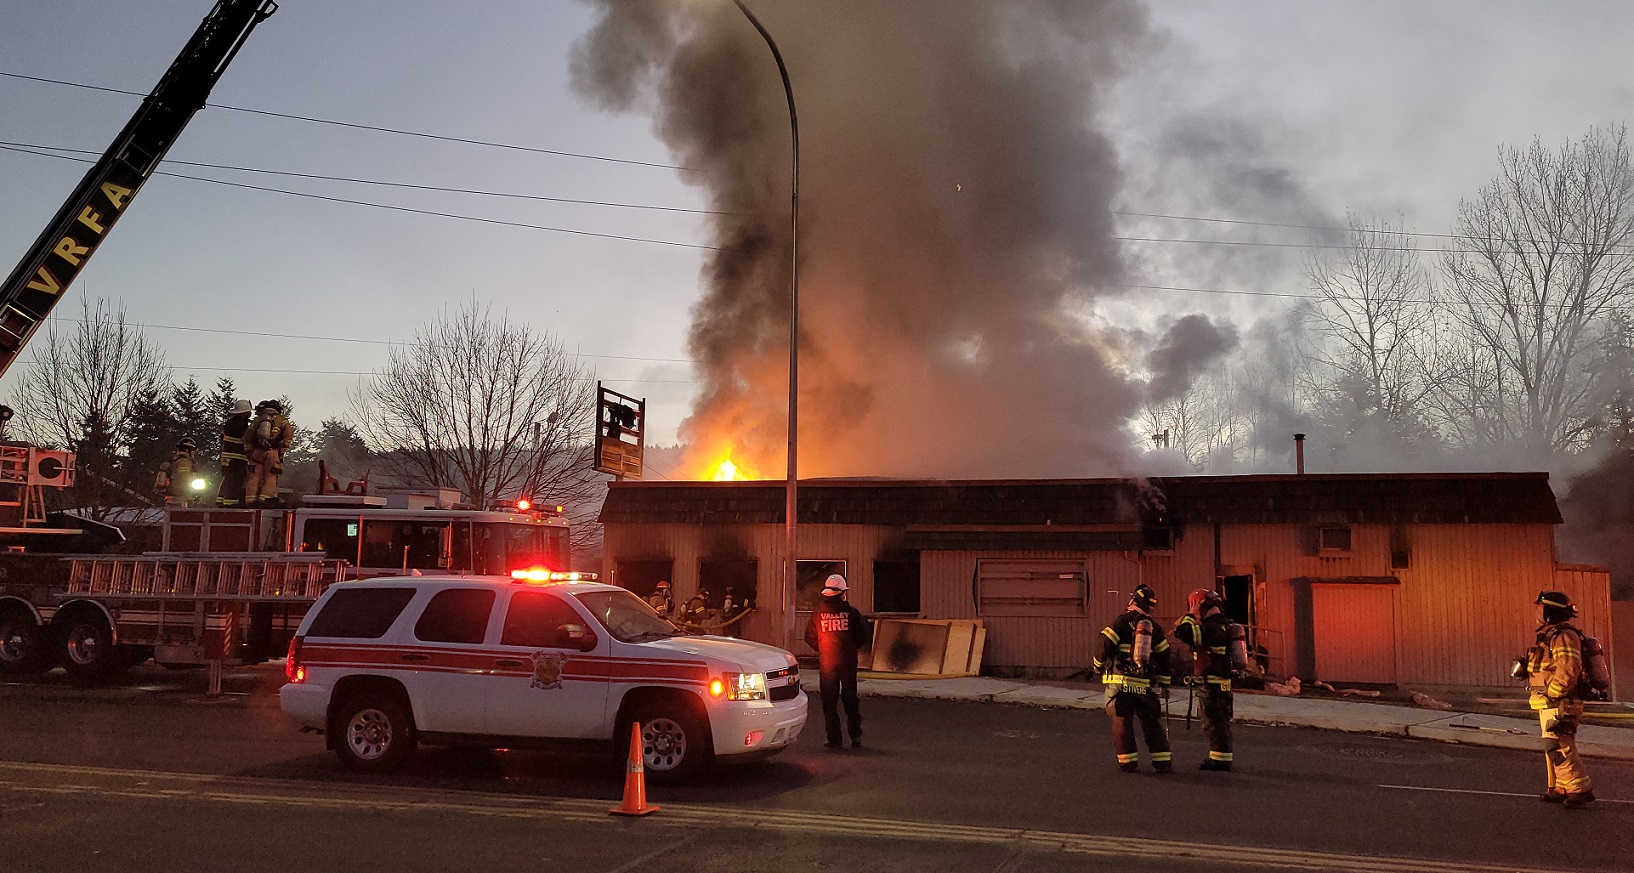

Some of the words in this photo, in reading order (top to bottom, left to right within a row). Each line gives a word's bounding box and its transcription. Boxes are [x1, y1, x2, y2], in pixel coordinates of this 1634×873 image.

[26, 181, 132, 295] VRFA
[820, 611, 849, 620] VALLEY
[820, 618, 849, 632] FIRE
